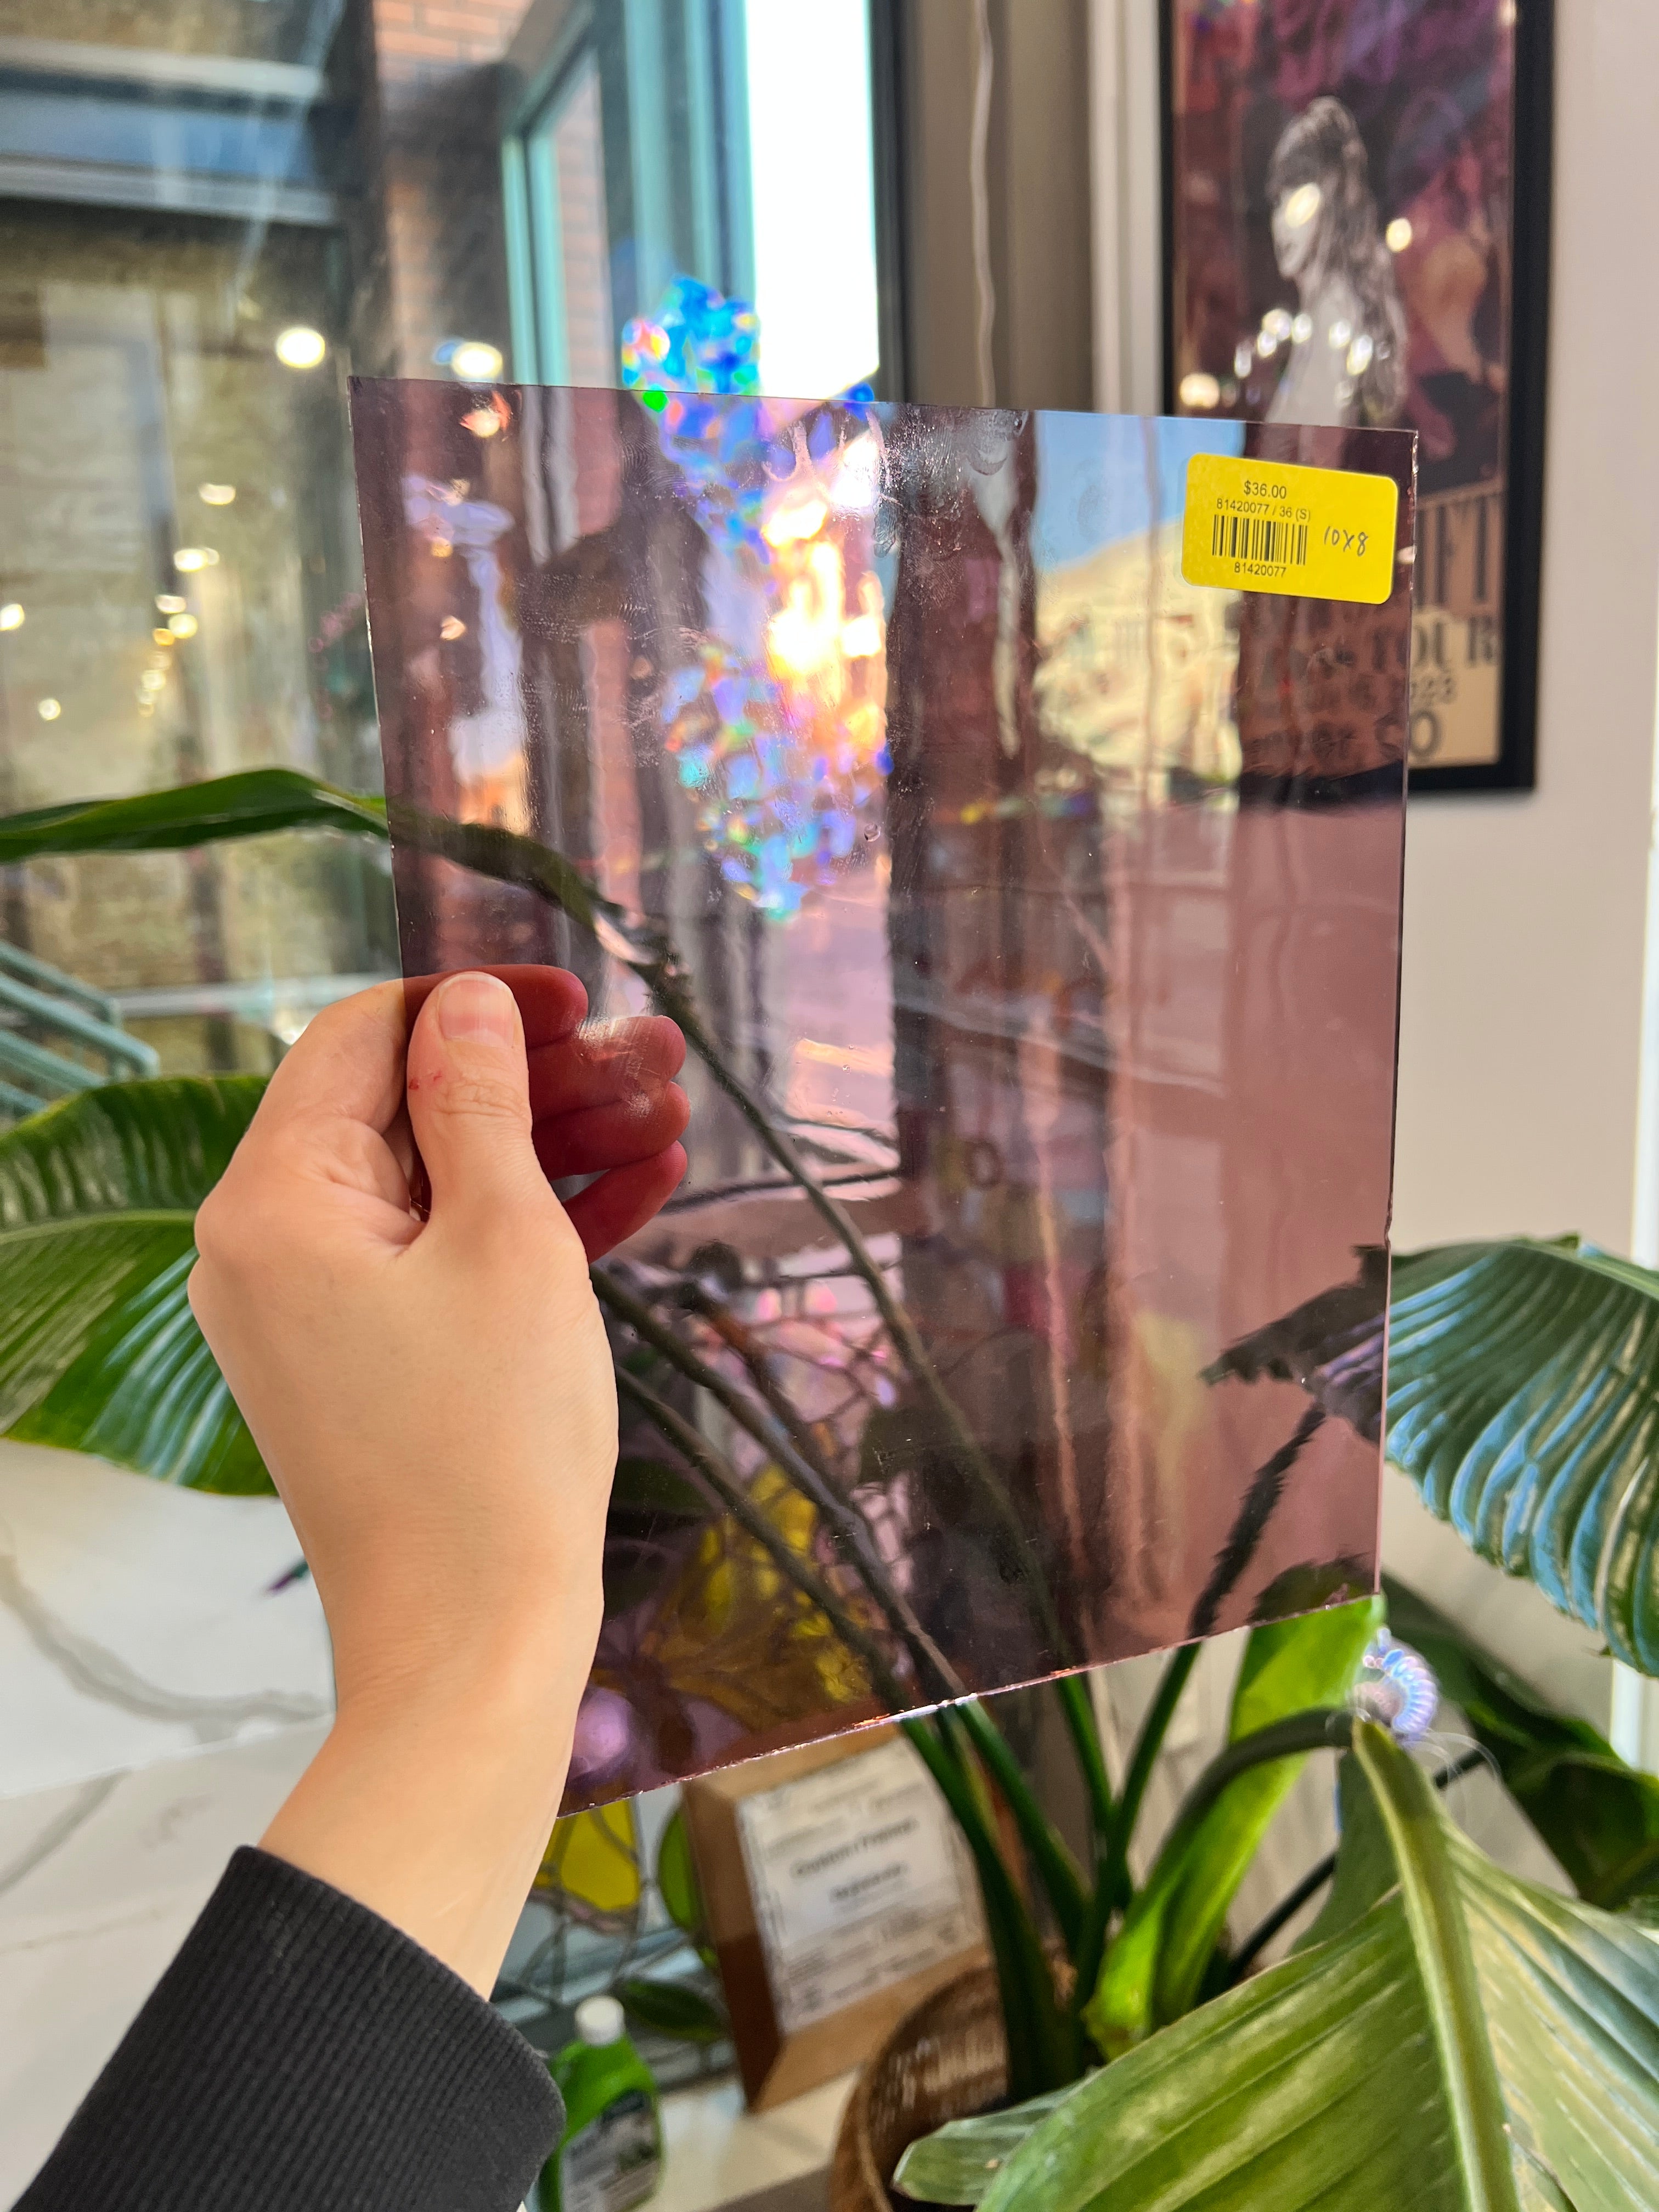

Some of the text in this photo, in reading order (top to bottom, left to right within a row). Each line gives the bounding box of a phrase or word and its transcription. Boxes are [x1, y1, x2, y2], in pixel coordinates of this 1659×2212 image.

[1243, 479, 1287, 499] $36.00
[1216, 498, 1269, 515] 81420077
[1279, 506, 1292, 518] 36
[1295, 508, 1311, 522] (S)
[1234, 562, 1286, 578] 81420077
